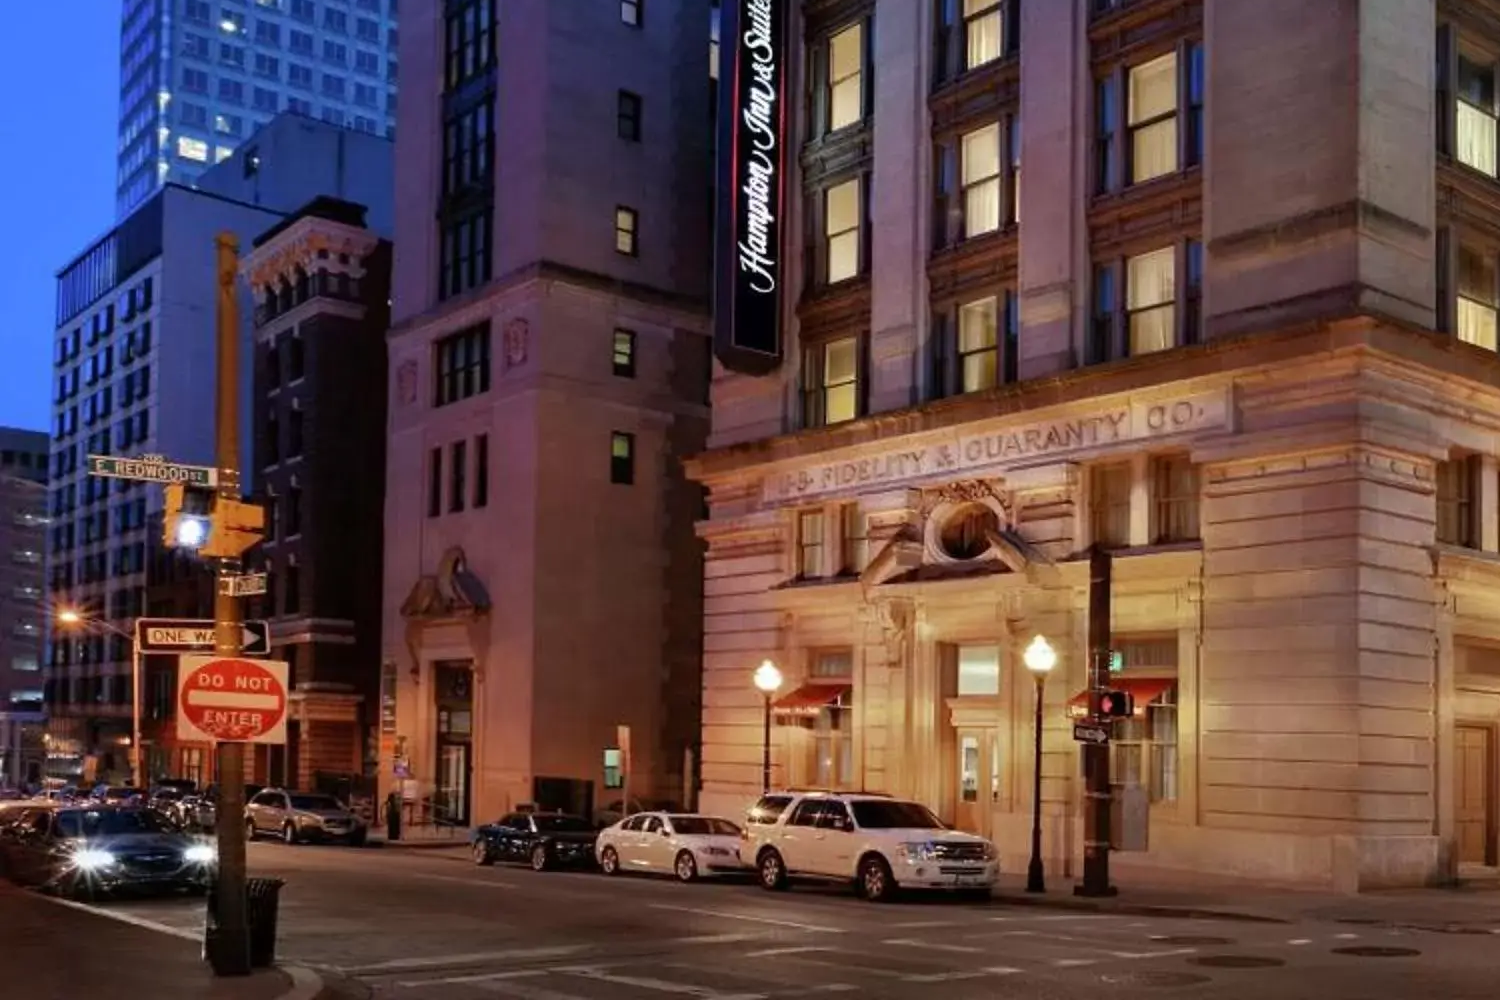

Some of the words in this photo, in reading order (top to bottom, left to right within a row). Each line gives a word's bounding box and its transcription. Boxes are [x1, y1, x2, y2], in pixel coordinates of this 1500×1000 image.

[752, 62, 775, 80] &
[742, 77, 775, 151] Inn
[738, 150, 775, 293] Hampton
[821, 450, 926, 488] FIDELITY
[965, 411, 1127, 461] GUARANTY
[115, 461, 189, 481] REDWOOD
[153, 630, 185, 643] ONE
[194, 631, 217, 643] WA
[199, 673, 224, 687] DO
[235, 675, 272, 691] NOT
[203, 710, 263, 727] ENTER
